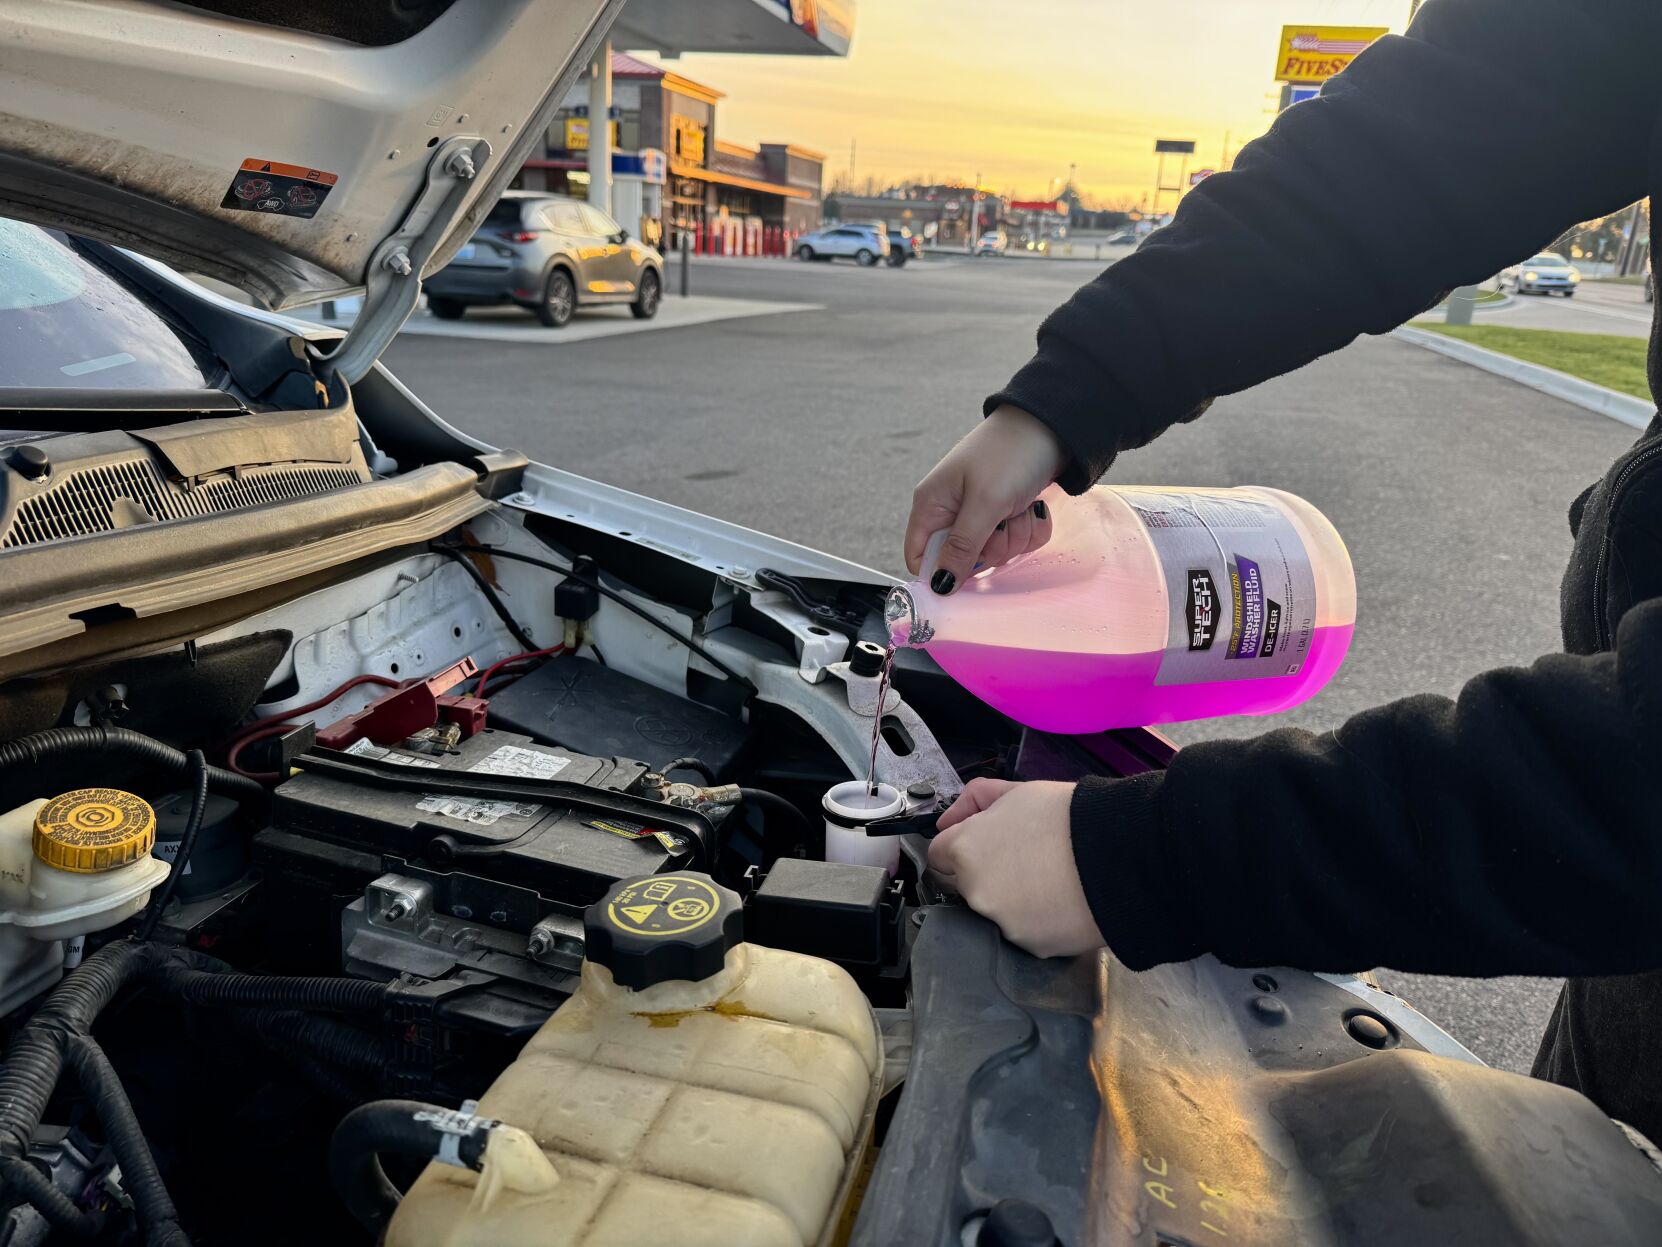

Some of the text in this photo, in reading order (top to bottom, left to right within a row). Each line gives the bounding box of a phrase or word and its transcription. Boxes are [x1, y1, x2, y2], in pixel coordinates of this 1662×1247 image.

[1282, 56, 1348, 76] FIVES
[1192, 578, 1202, 647] SUPER
[1200, 577, 1212, 646] TECH
[1231, 573, 1241, 629] PROTECTION
[1240, 580, 1254, 654] WINDSHIELD
[1247, 568, 1261, 654] WASHER FLUID
[1264, 609, 1279, 652] DE-ICER
[1143, 1157, 1177, 1209] AC
